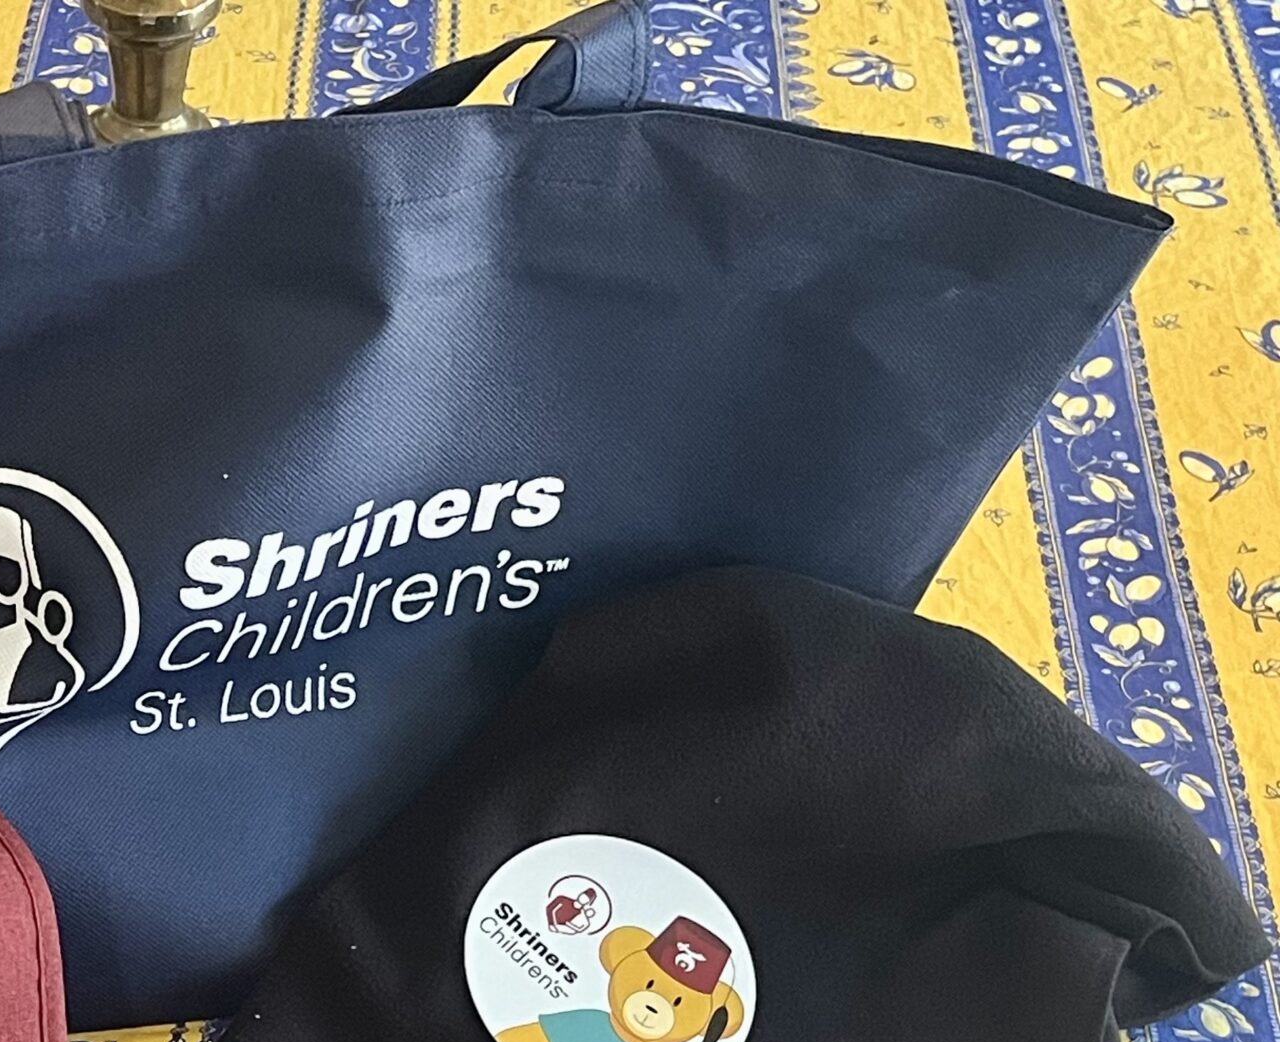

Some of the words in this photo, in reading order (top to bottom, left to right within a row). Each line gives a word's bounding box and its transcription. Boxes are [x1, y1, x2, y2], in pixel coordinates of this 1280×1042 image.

[179, 475, 566, 610] Shriners
[129, 690, 197, 735] St.
[220, 663, 357, 724] Louis
[494, 902, 579, 985] Shriners
